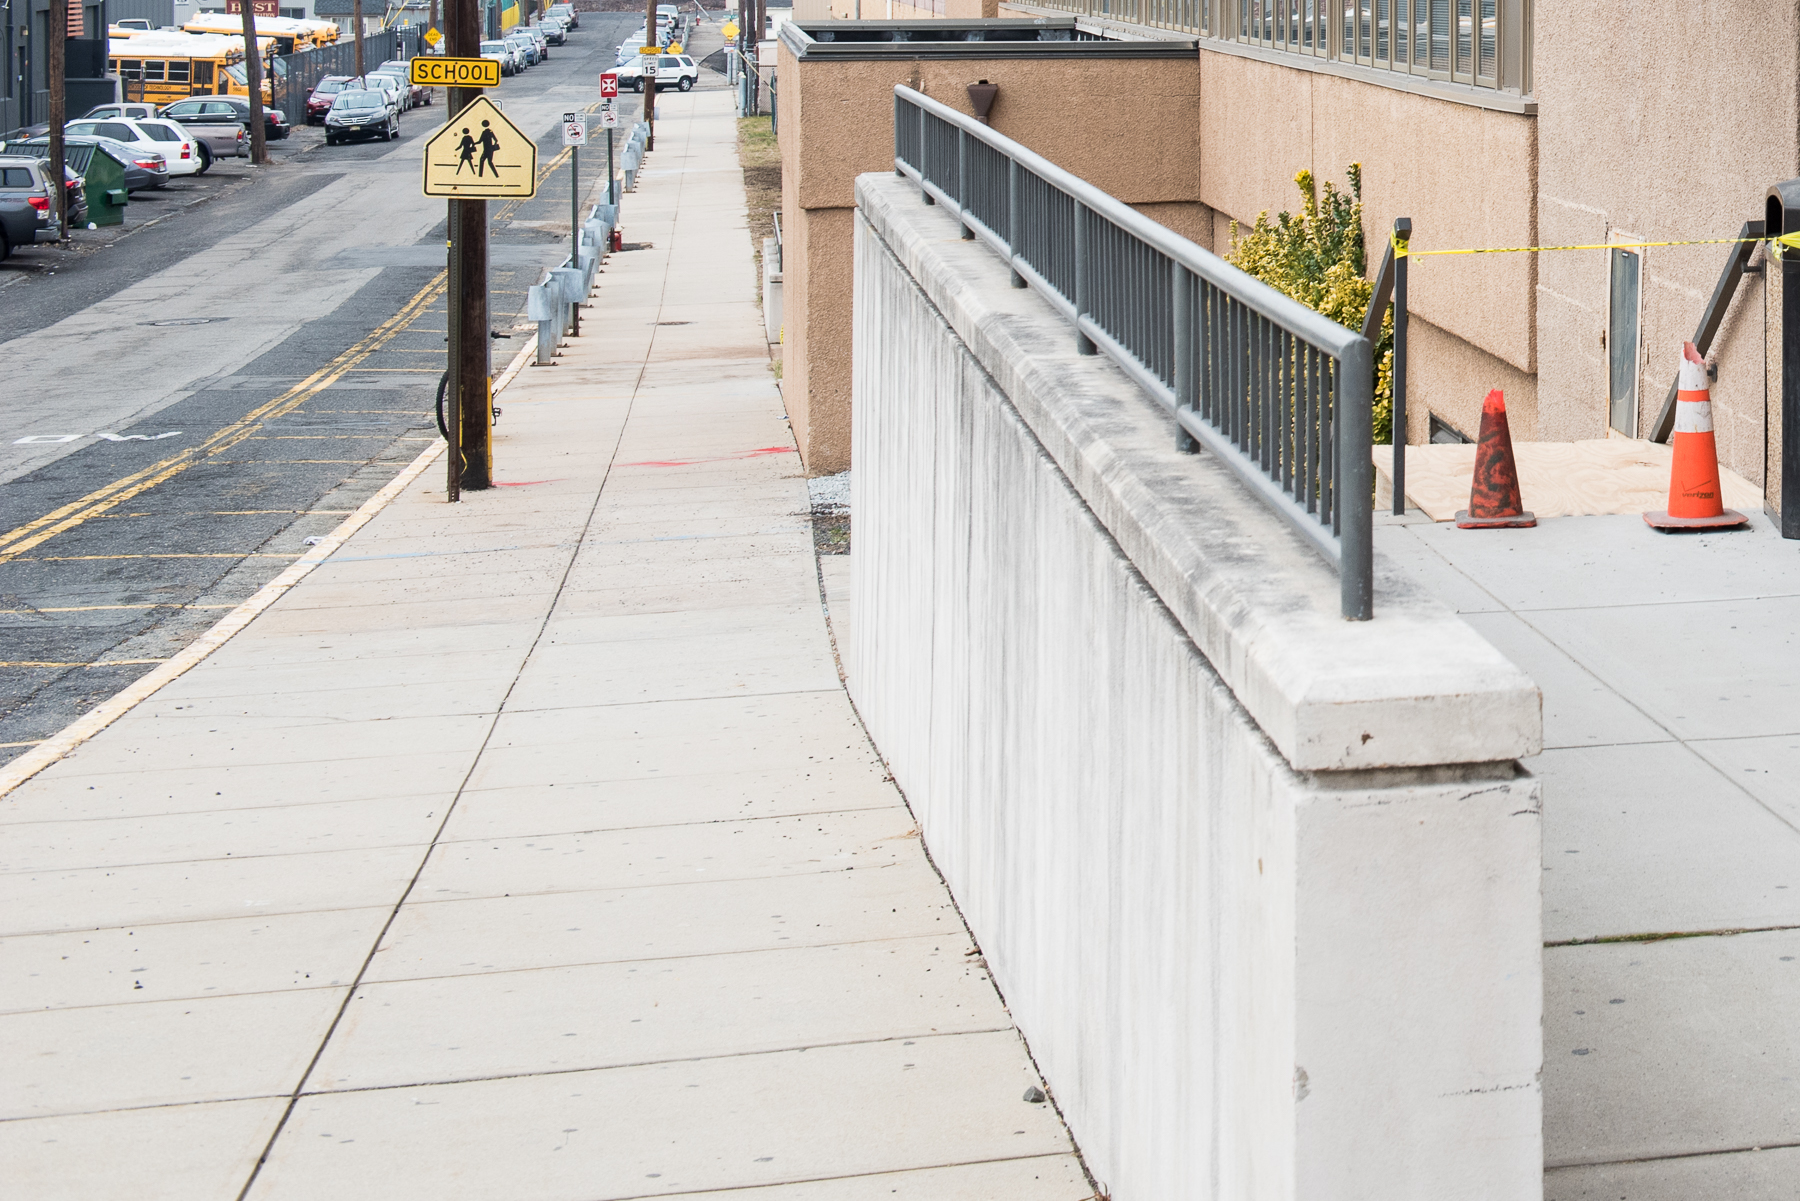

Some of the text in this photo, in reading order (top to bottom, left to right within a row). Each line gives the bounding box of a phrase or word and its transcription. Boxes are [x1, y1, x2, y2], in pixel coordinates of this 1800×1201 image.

[231, 3, 276, 12] HST
[418, 64, 494, 80] SCHOOL
[645, 66, 656, 74] 15
[1682, 491, 1714, 499] verizon
